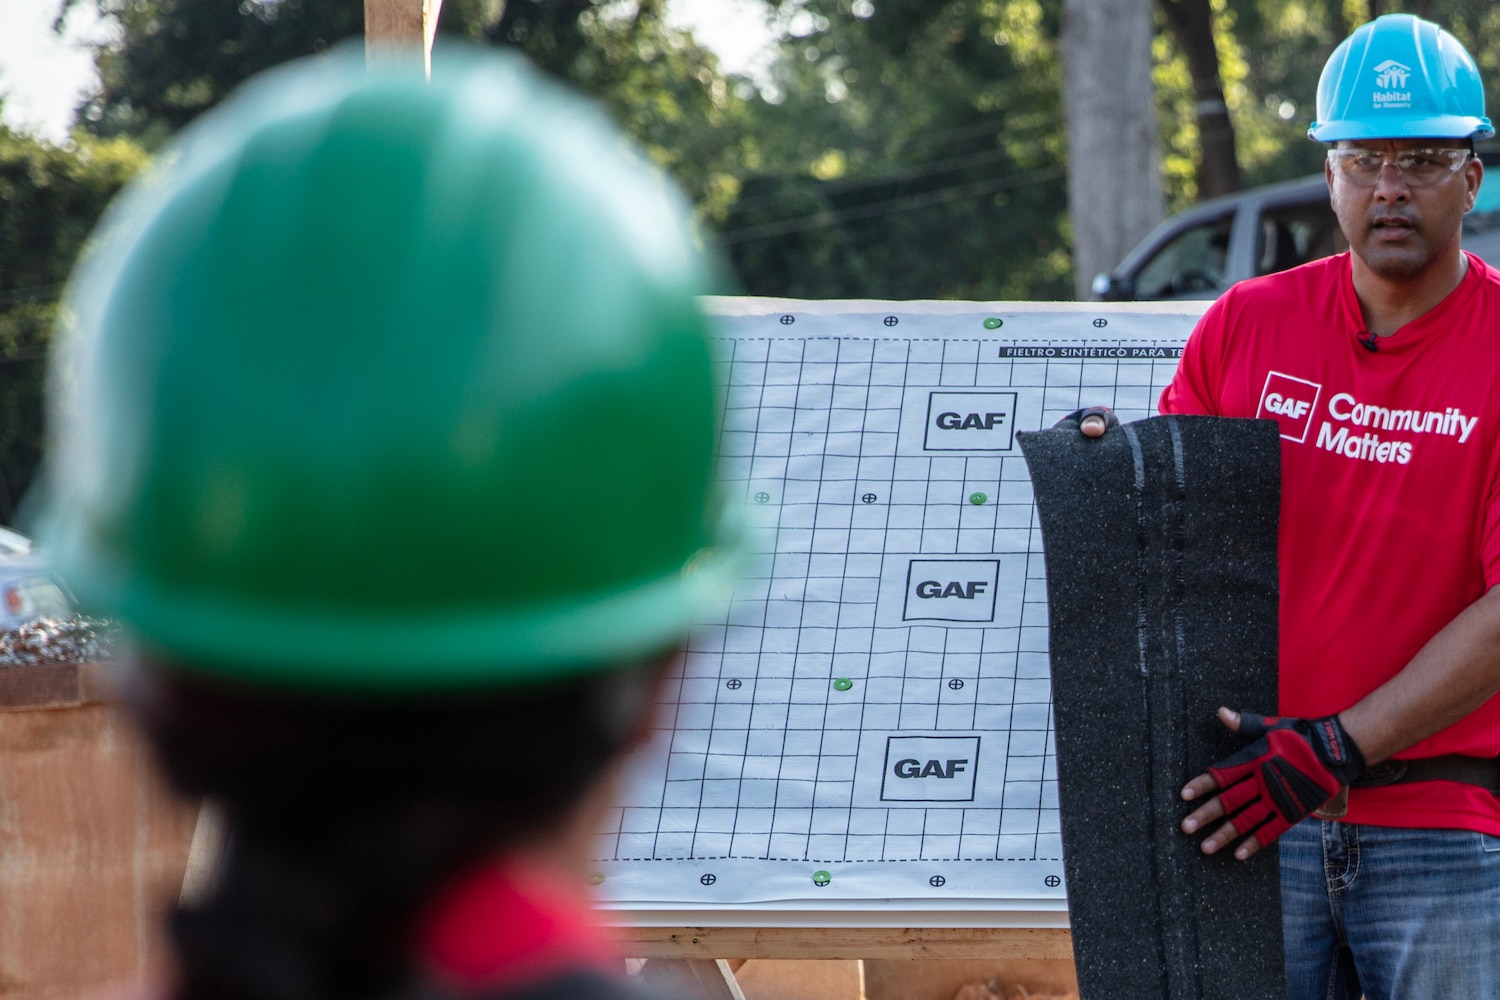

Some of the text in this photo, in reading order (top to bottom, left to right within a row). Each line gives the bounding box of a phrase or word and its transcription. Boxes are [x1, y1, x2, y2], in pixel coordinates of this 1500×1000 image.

[1373, 91, 1412, 102] Habitat
[1006, 348, 1056, 357] FIELTRO
[1132, 348, 1166, 357] PARA
[1170, 348, 1184, 357] TE
[1264, 392, 1310, 420] GAF
[936, 411, 1006, 430] GAF
[1328, 392, 1479, 444] Community
[1315, 421, 1413, 465] Matters
[915, 580, 988, 599] GAF
[894, 758, 969, 779] GAF
